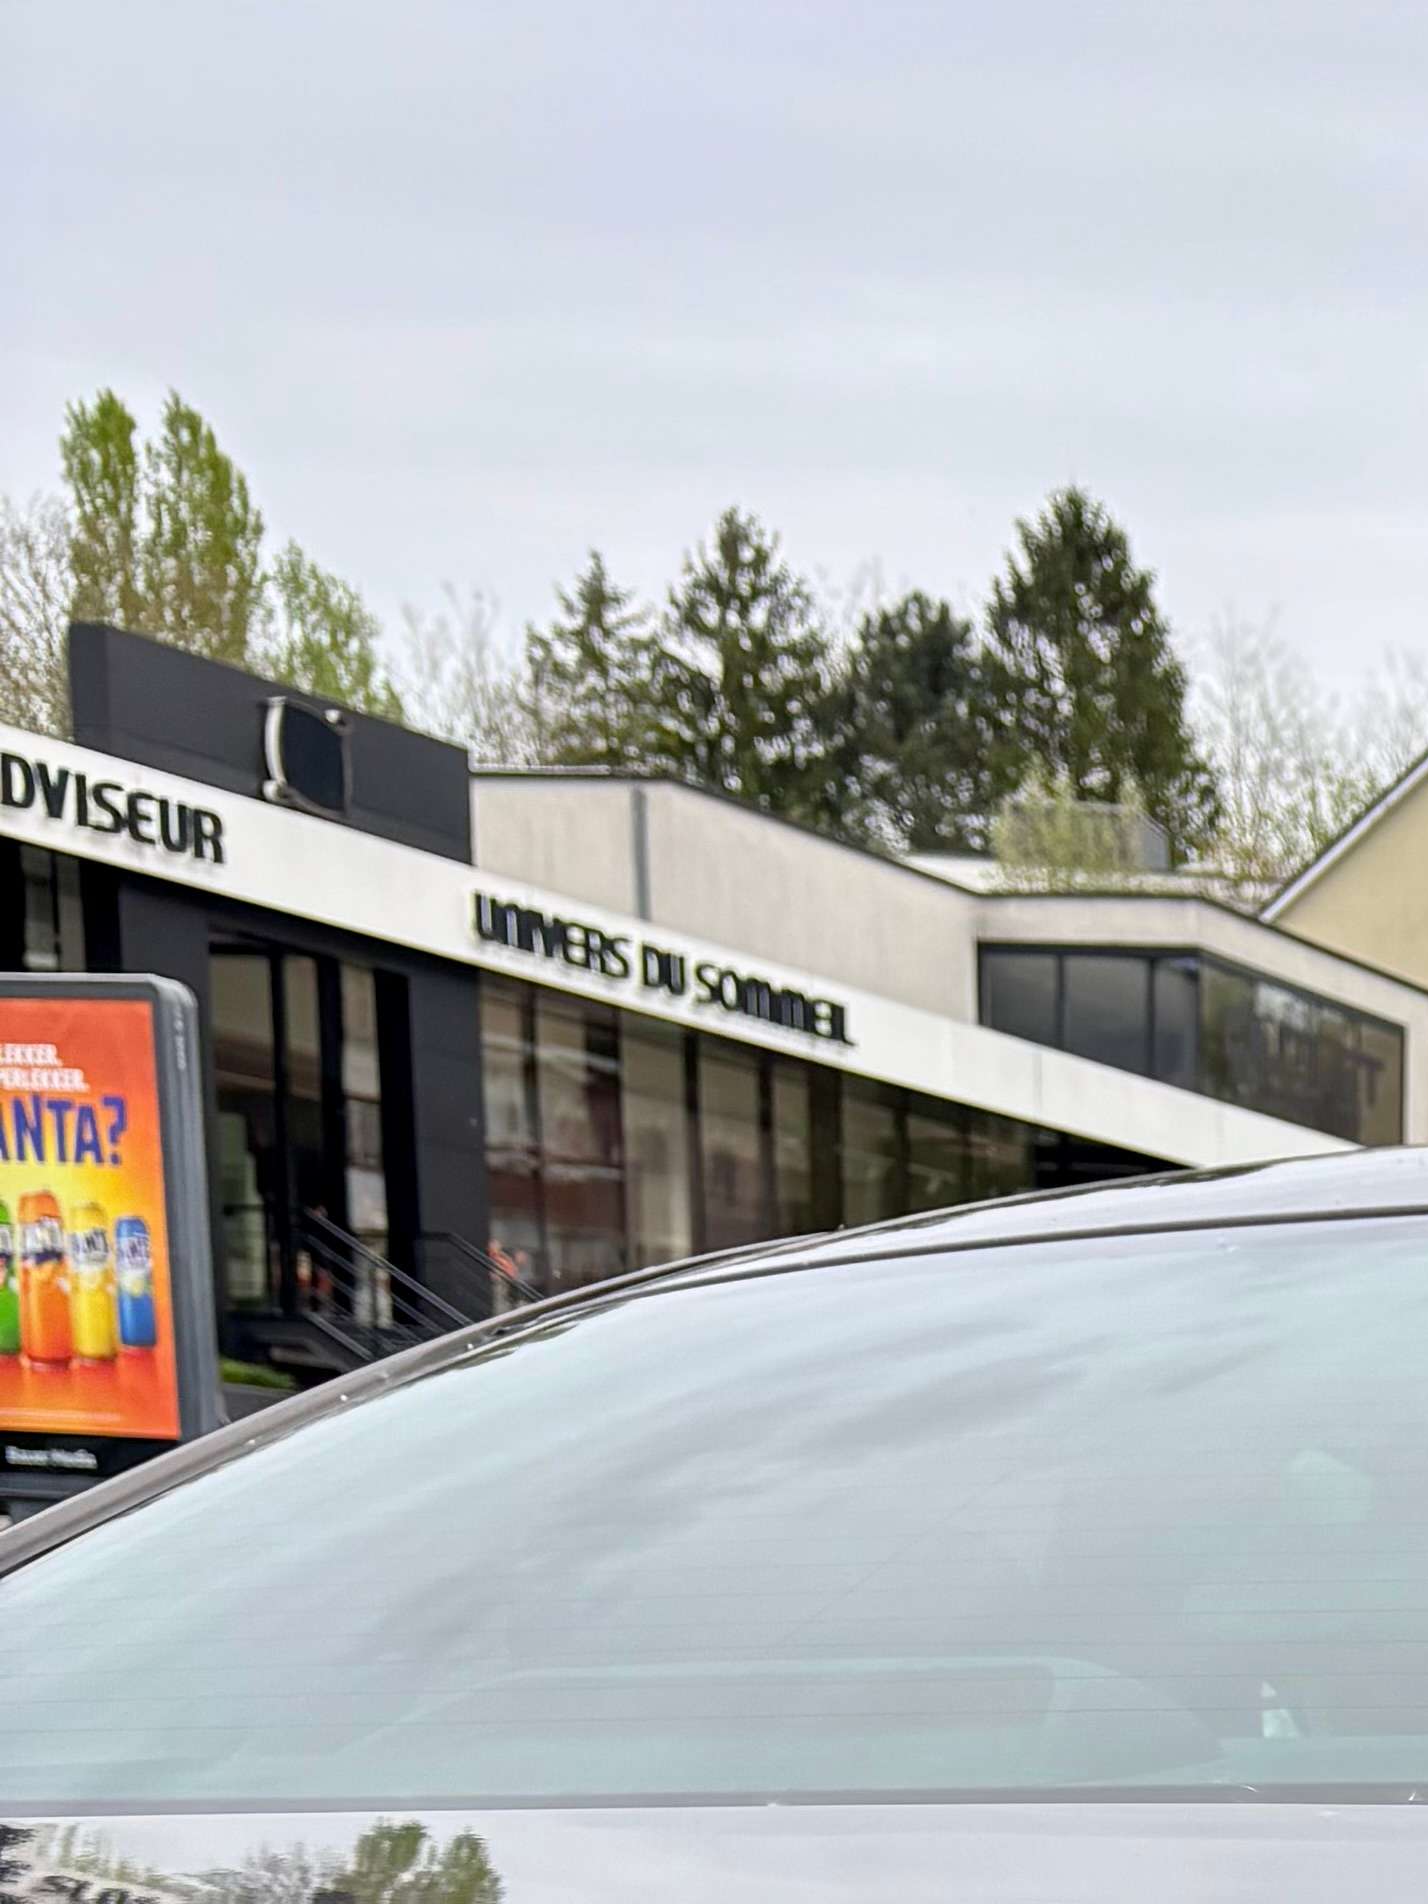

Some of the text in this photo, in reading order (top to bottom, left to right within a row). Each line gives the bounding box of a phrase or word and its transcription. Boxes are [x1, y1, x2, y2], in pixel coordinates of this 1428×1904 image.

[1, 751, 225, 864] DVISEUR
[475, 890, 633, 979] UNIVERS
[641, 942, 687, 996] DU
